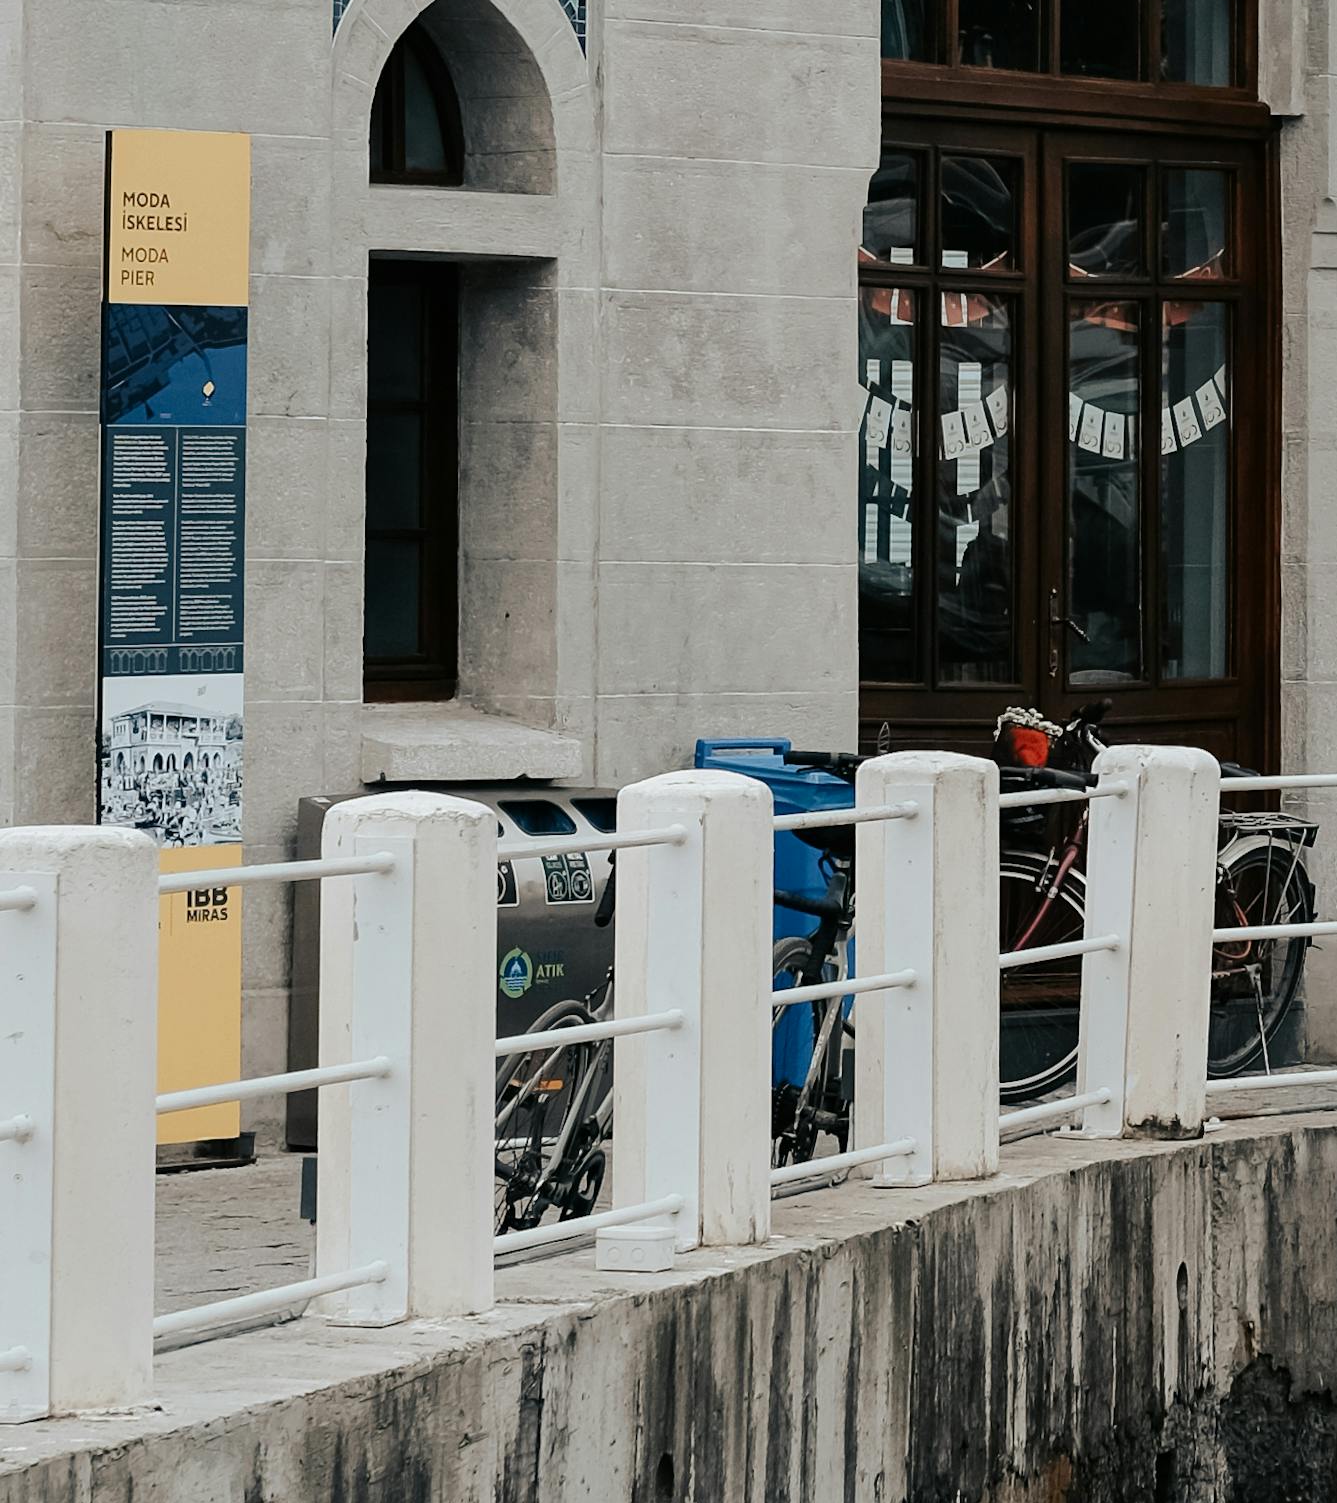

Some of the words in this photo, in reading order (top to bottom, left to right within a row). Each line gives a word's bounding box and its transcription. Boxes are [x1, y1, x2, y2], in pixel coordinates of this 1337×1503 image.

[122, 191, 170, 208] MODA
[122, 210, 187, 232] İSKELESİ
[121, 246, 169, 263] MODA
[121, 270, 155, 286] PIER
[186, 908, 228, 923] MIRAS
[536, 964, 565, 978] ATIK
